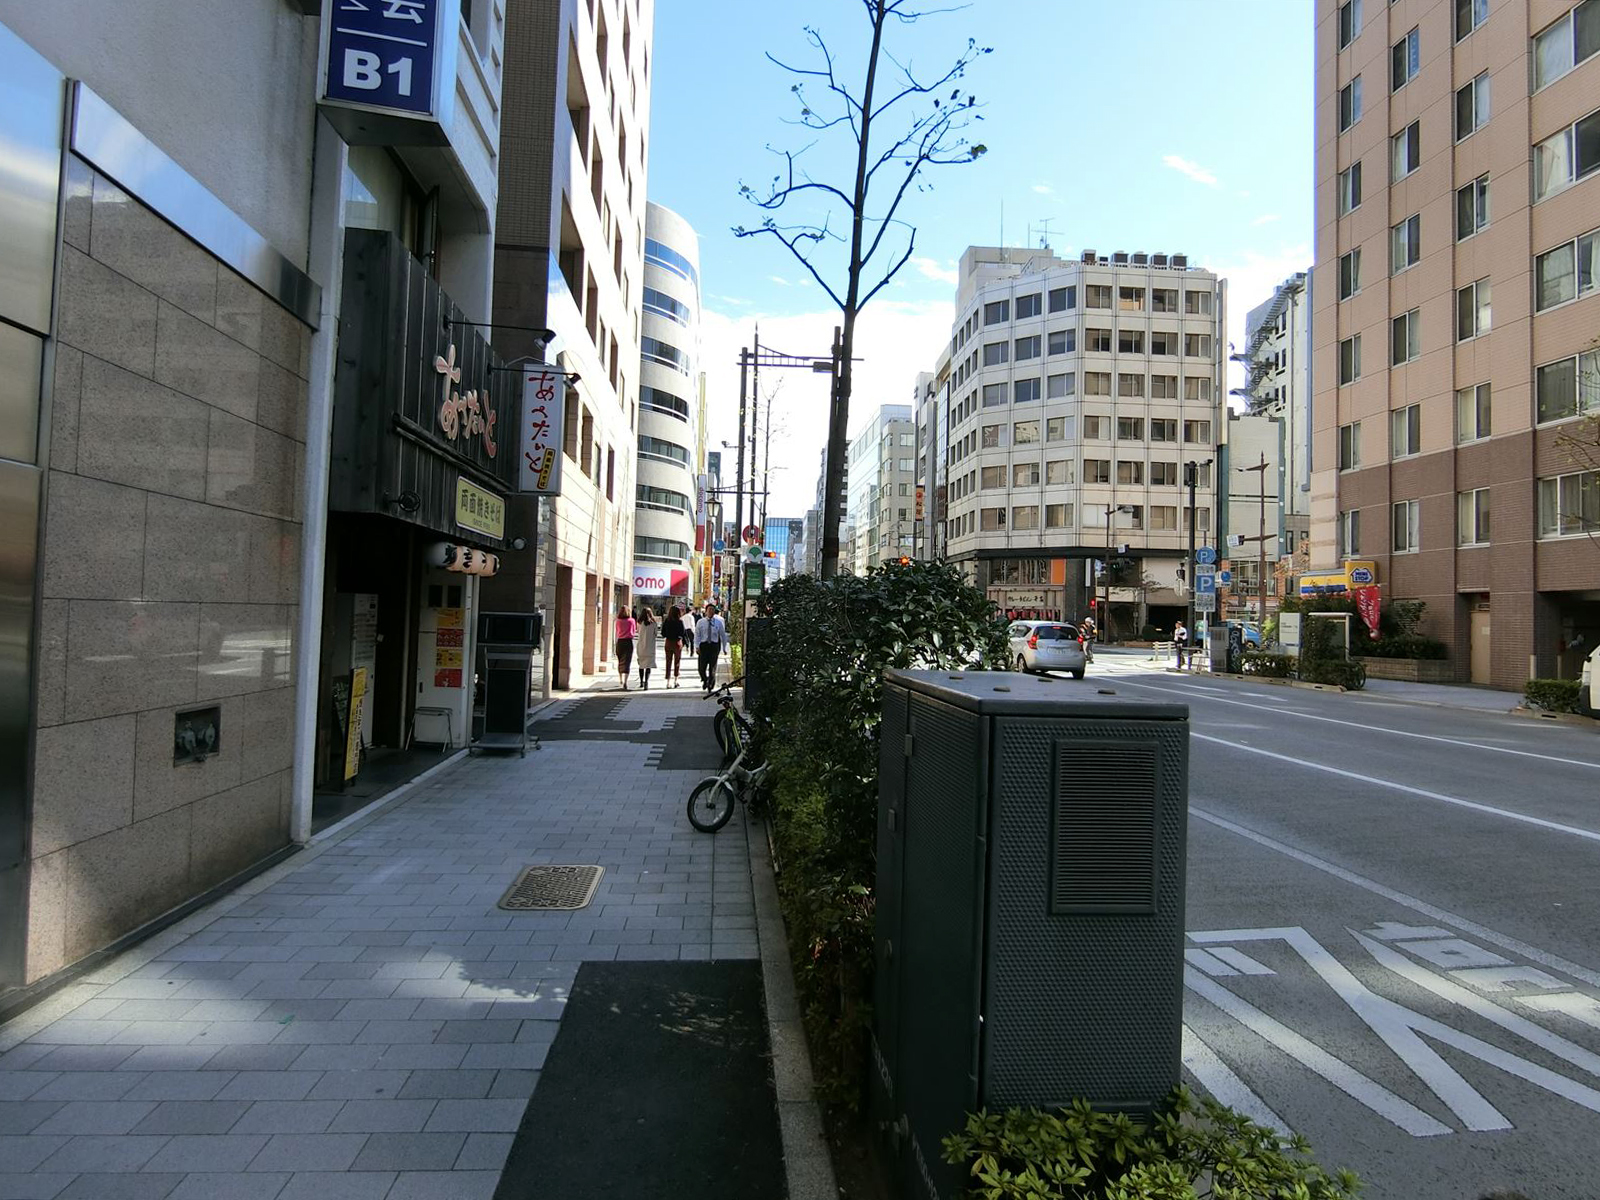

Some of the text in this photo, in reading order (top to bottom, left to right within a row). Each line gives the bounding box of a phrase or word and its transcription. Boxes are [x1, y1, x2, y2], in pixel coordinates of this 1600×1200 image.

[343, 48, 412, 96] B1
[633, 576, 665, 589] omo
[1201, 577, 1212, 591] P
